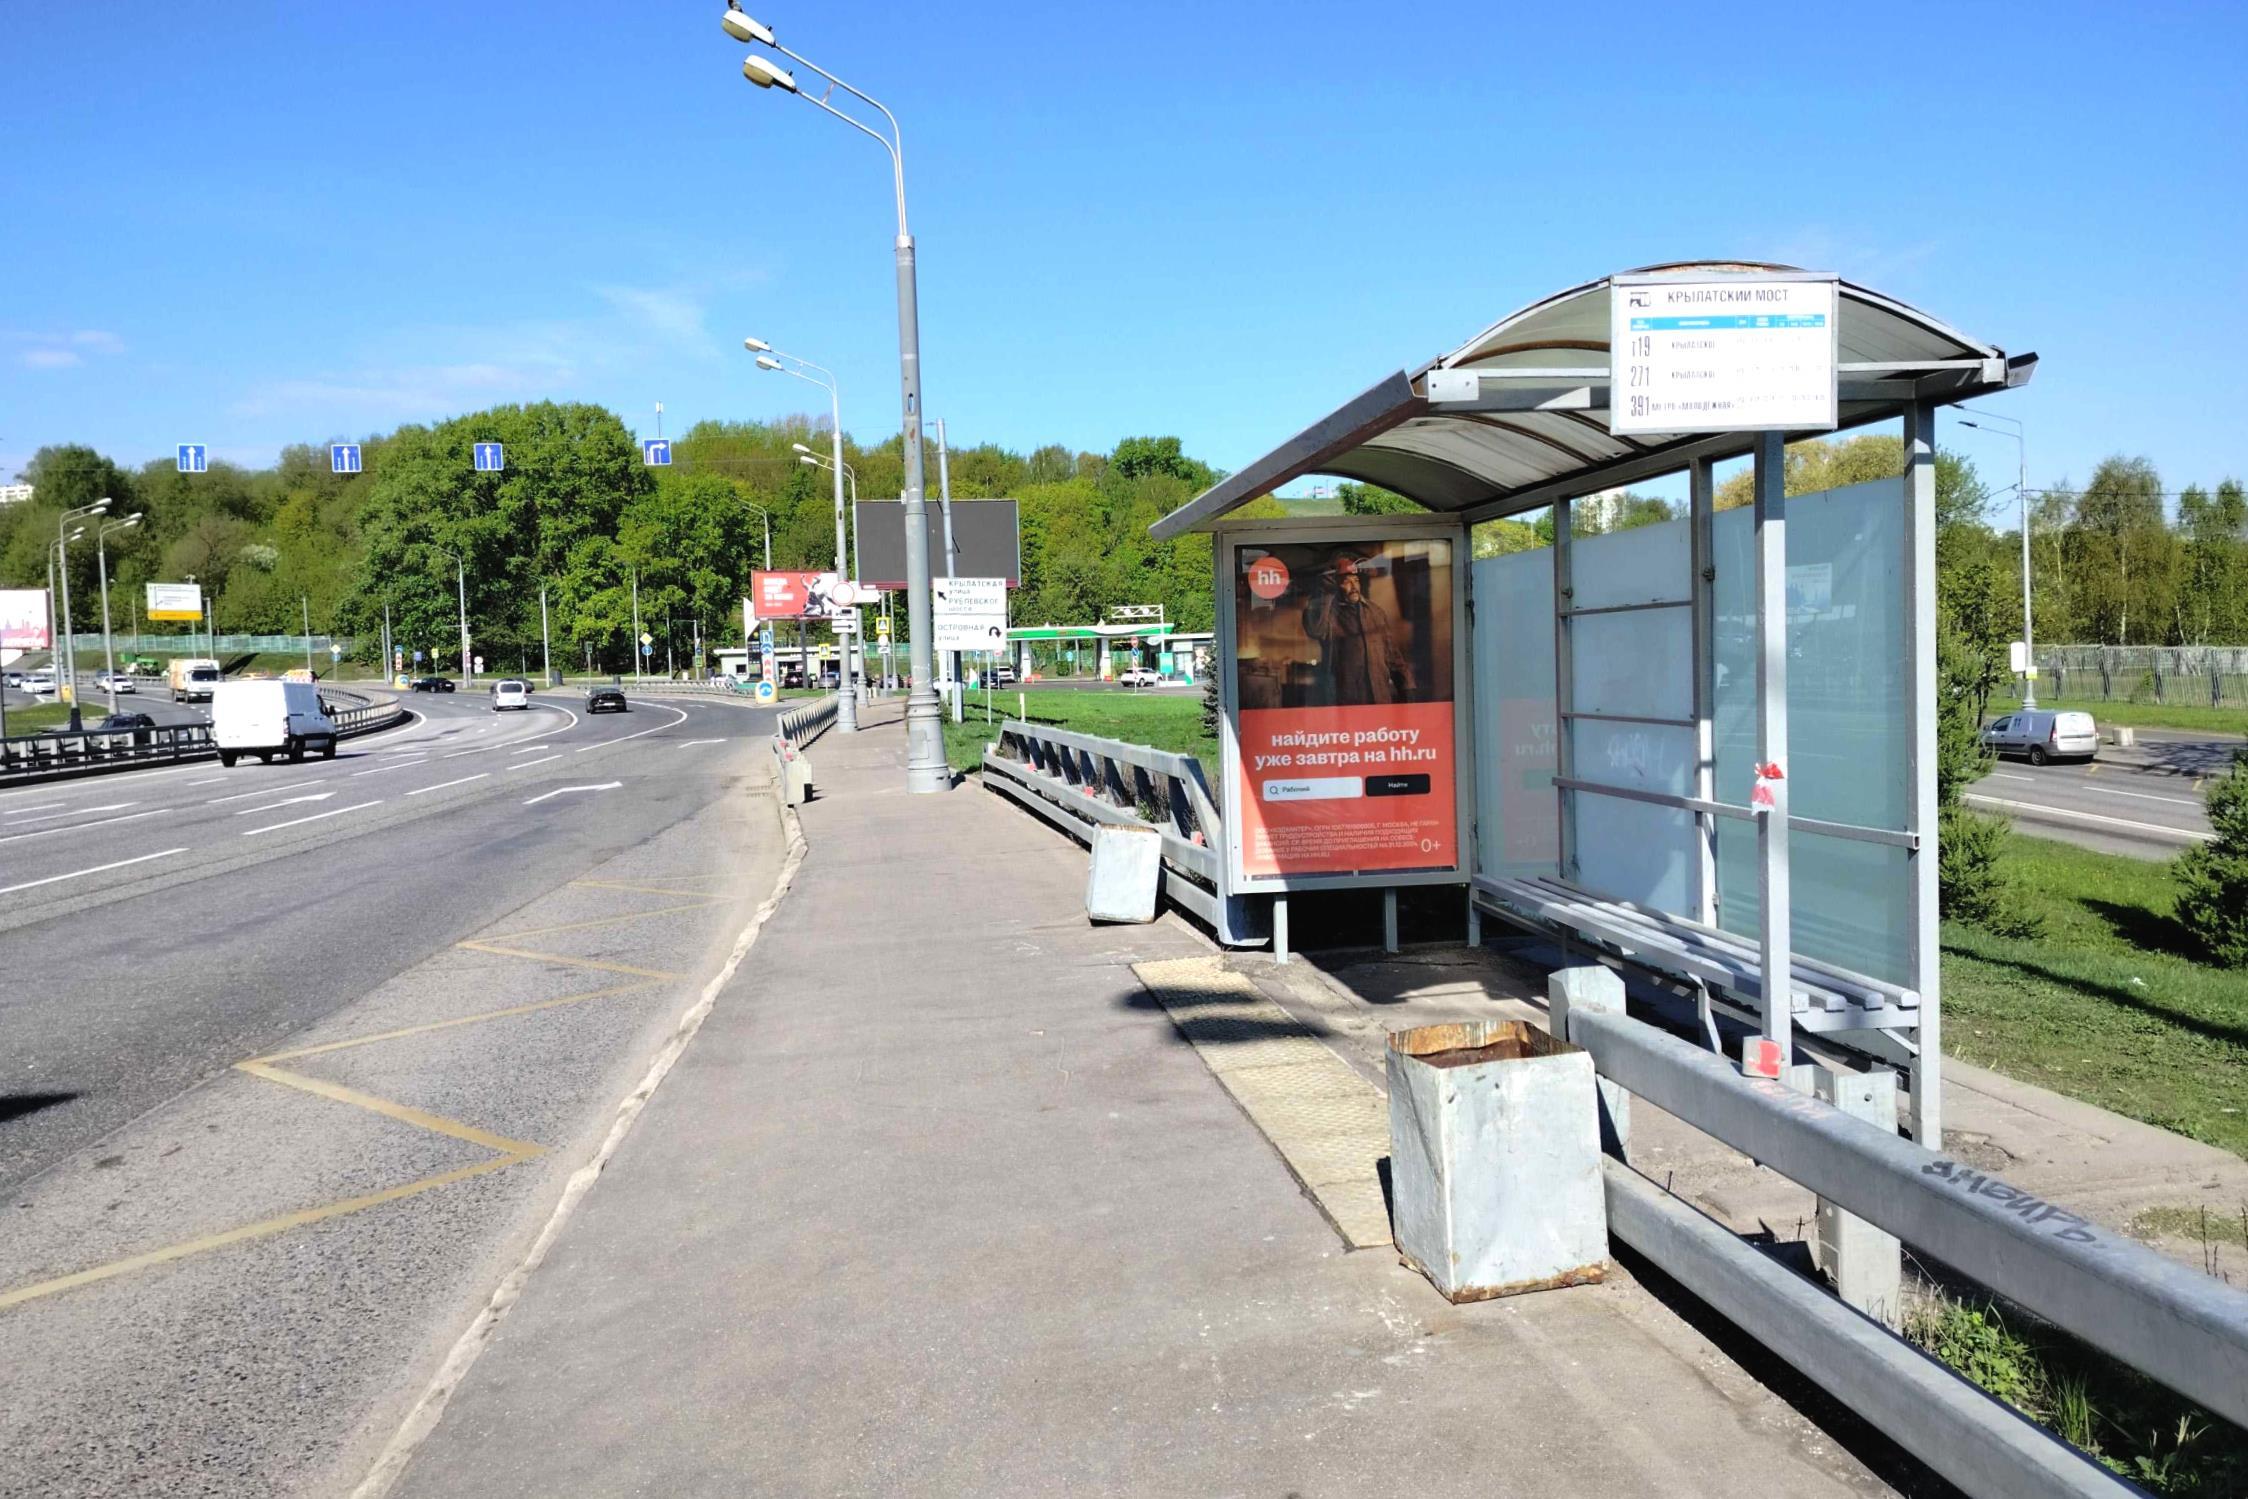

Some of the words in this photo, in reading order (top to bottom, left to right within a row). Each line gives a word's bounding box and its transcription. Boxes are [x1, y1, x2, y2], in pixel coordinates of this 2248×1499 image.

[1755, 288, 1789, 303] МОСТ
[1630, 365, 1650, 387] 271
[1630, 394, 1650, 417] 391
[1257, 569, 1281, 586] hh
[1271, 730, 1350, 748] найдите
[1354, 727, 1420, 746] работу
[1255, 753, 1292, 770] уже
[1295, 751, 1360, 767] завтра
[1364, 750, 1386, 763] на
[1390, 745, 1437, 762] hh.ru
[1421, 838, 1441, 853] 0+
